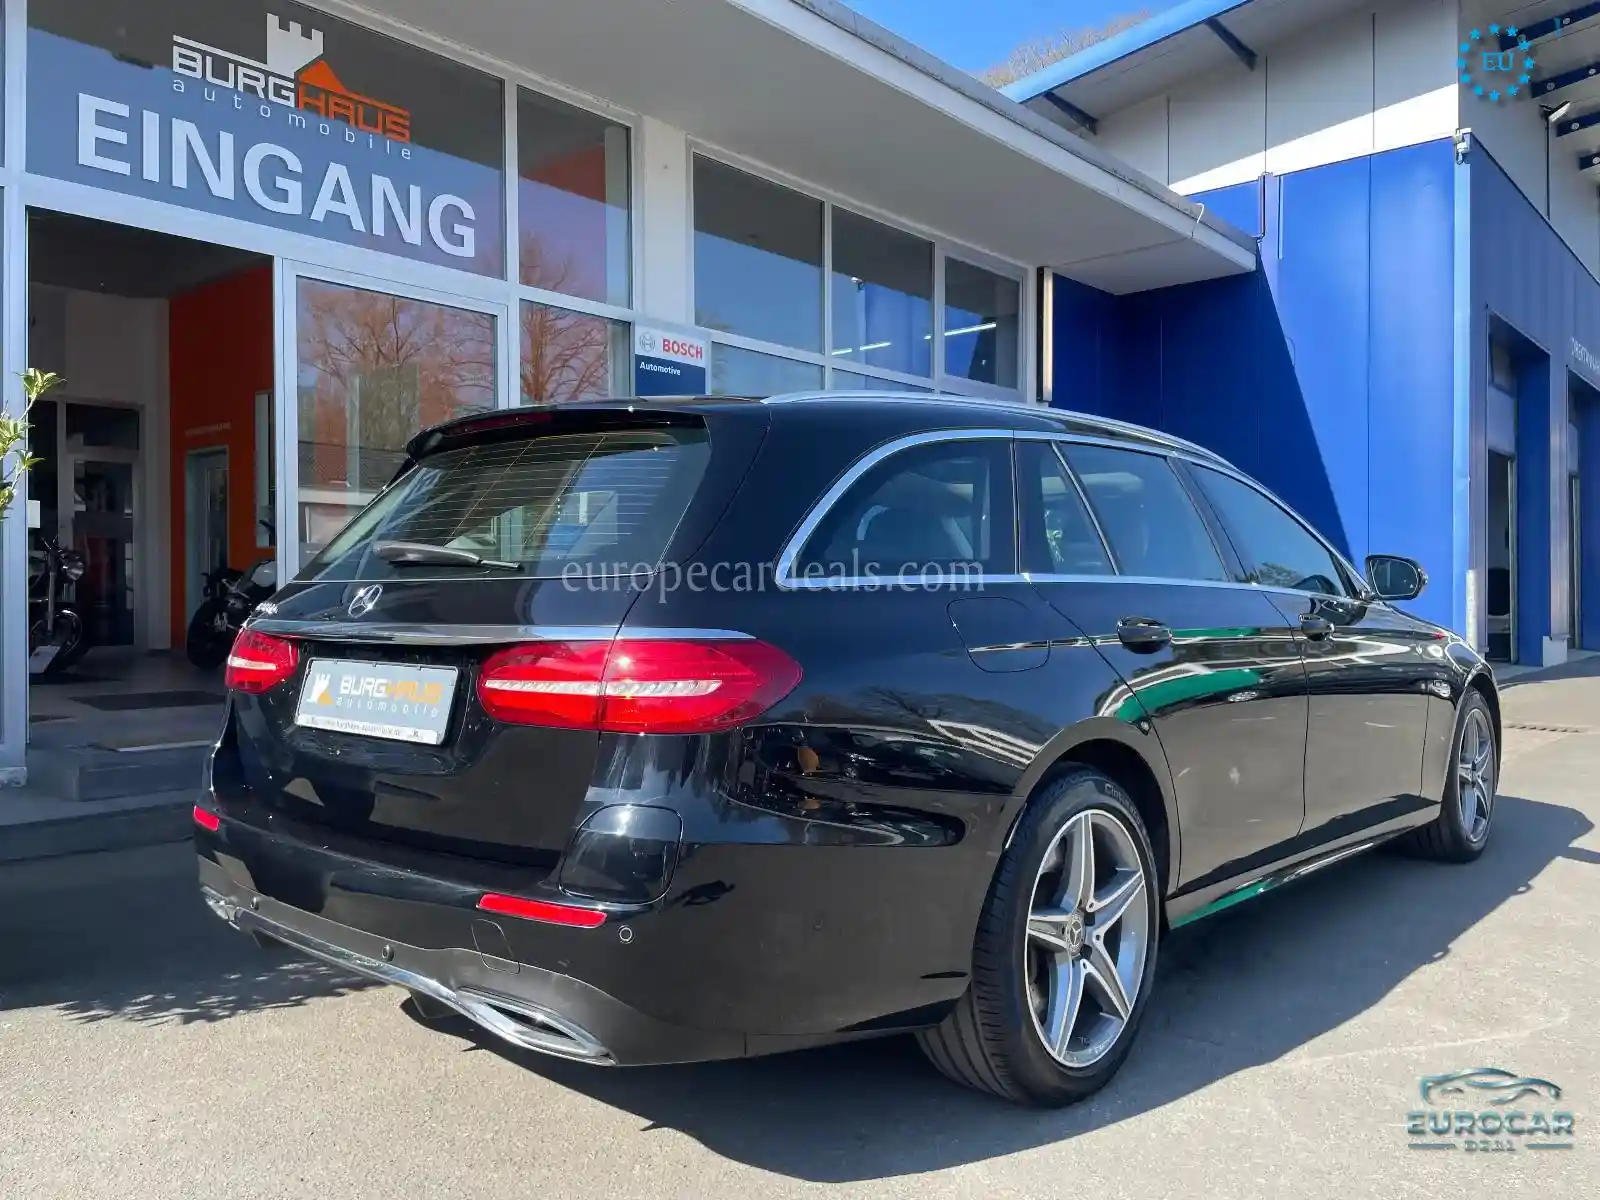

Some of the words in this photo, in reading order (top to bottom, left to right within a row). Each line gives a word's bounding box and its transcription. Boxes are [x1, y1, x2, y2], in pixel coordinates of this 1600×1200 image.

[173, 45, 411, 144] BURGHAUS
[173, 80, 411, 160] automobile
[78, 92, 476, 258] EINGANG
[639, 361, 681, 376] Automotive
[662, 338, 703, 360] BOSCH
[339, 674, 445, 704] BURGHAUS
